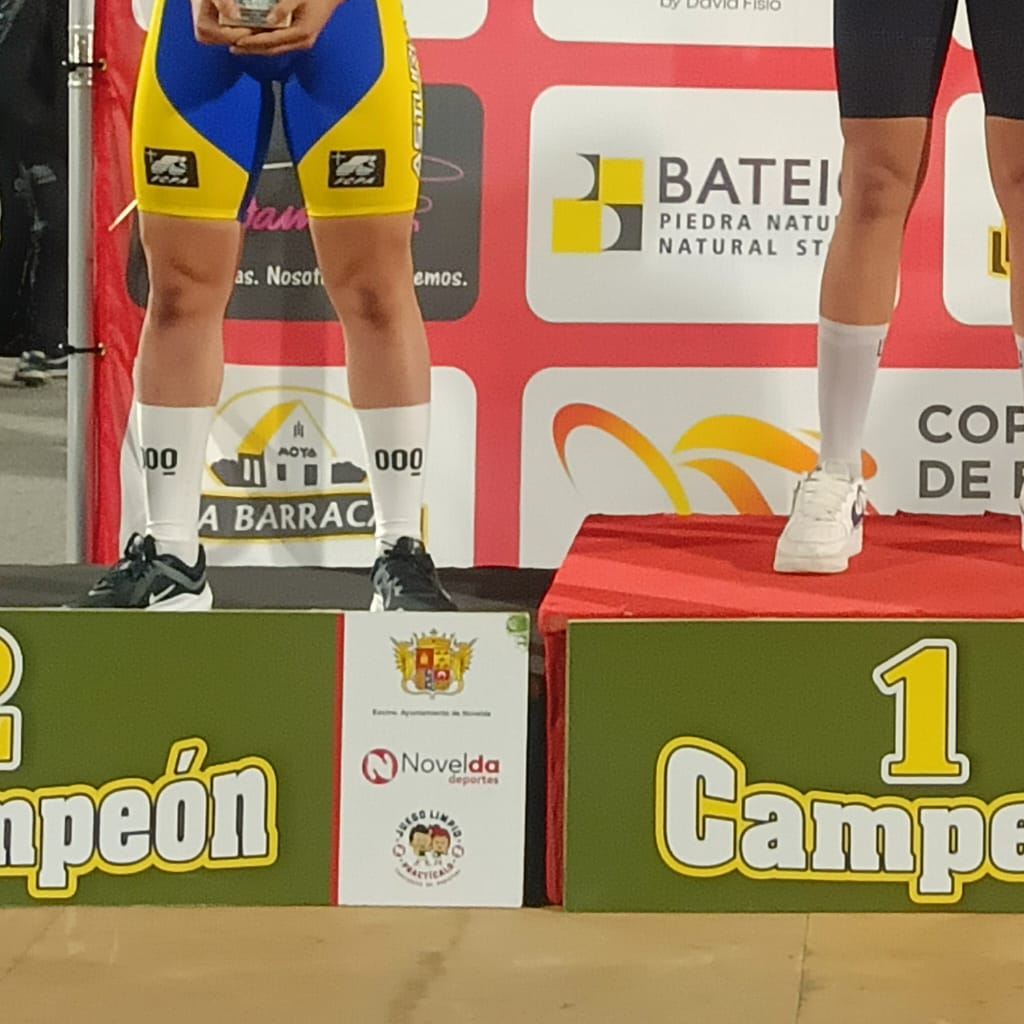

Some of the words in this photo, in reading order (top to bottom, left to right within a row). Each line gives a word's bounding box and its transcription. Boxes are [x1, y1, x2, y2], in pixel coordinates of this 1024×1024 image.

[659, 156, 842, 206] BATEI
[660, 213, 751, 231] PIEDRA
[658, 238, 777, 255] NATURAL
[277, 447, 317, 458] MOYA
[918, 460, 991, 499] DE
[874, 640, 968, 784] 1
[402, 752, 500, 773] Novelda
[449, 774, 498, 786] deportes
